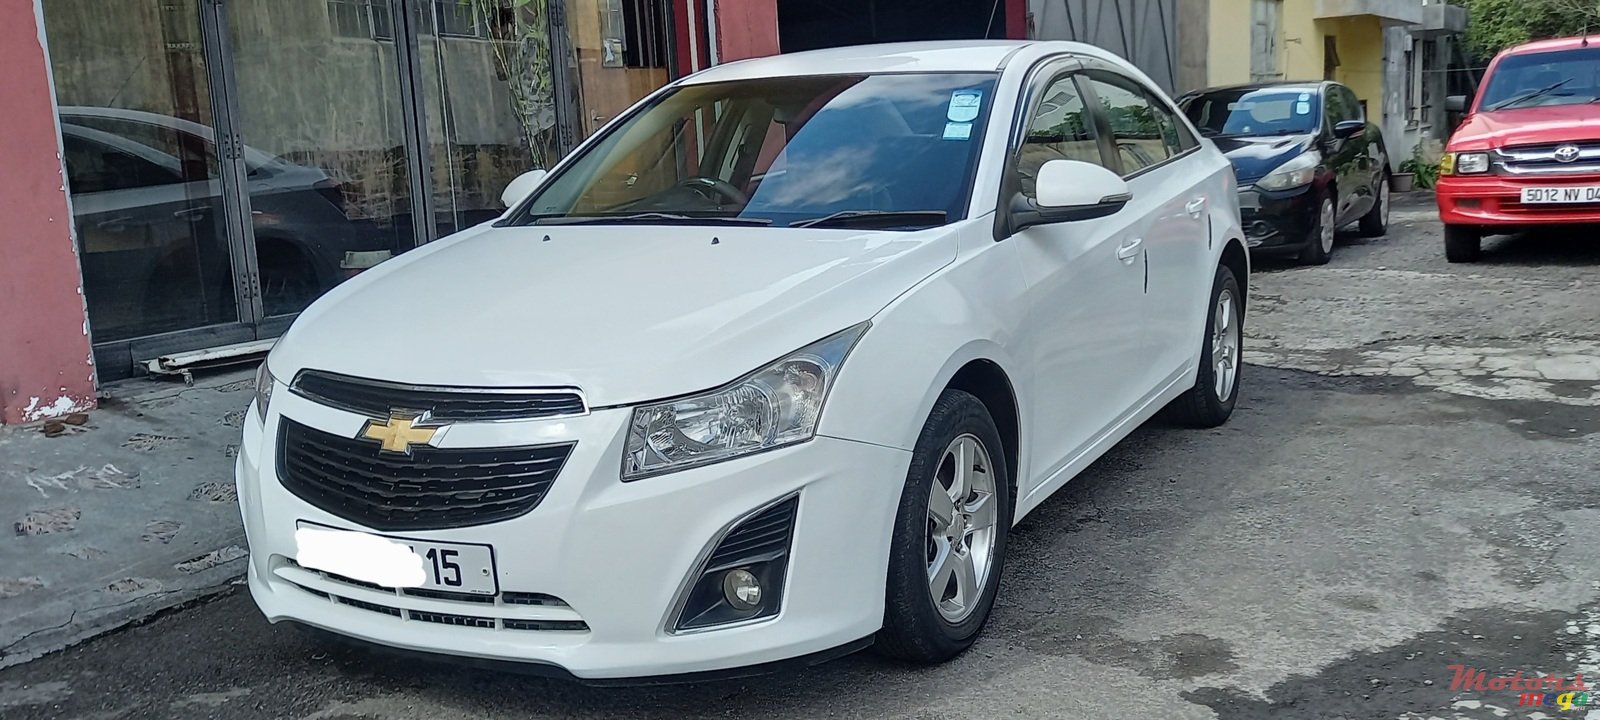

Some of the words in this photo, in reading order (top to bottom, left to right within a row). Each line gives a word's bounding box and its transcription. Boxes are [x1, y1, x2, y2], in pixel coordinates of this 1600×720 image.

[1526, 188, 1558, 201] 5012
[1564, 188, 1580, 201] NV
[426, 548, 462, 587] 15
